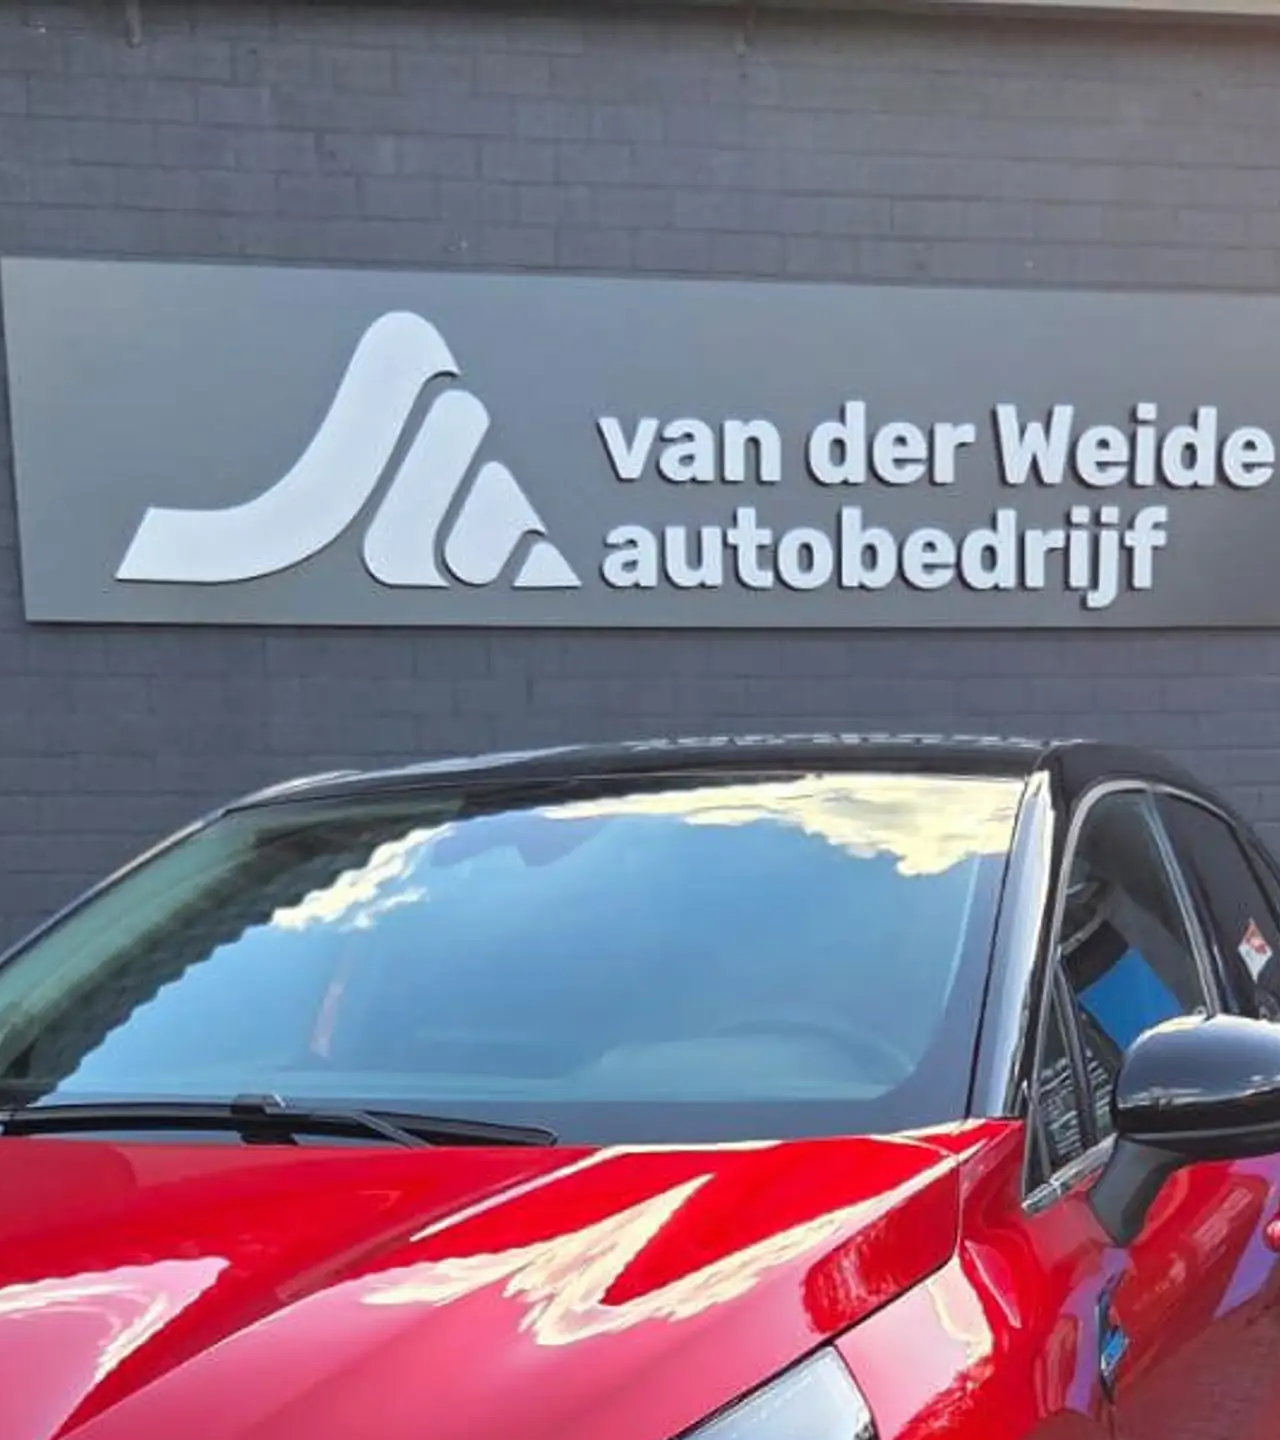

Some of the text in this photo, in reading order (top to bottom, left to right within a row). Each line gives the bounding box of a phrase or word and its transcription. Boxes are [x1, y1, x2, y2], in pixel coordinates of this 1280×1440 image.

[597, 401, 1276, 488] van der Weide
[601, 505, 1169, 609] autobedrijf
